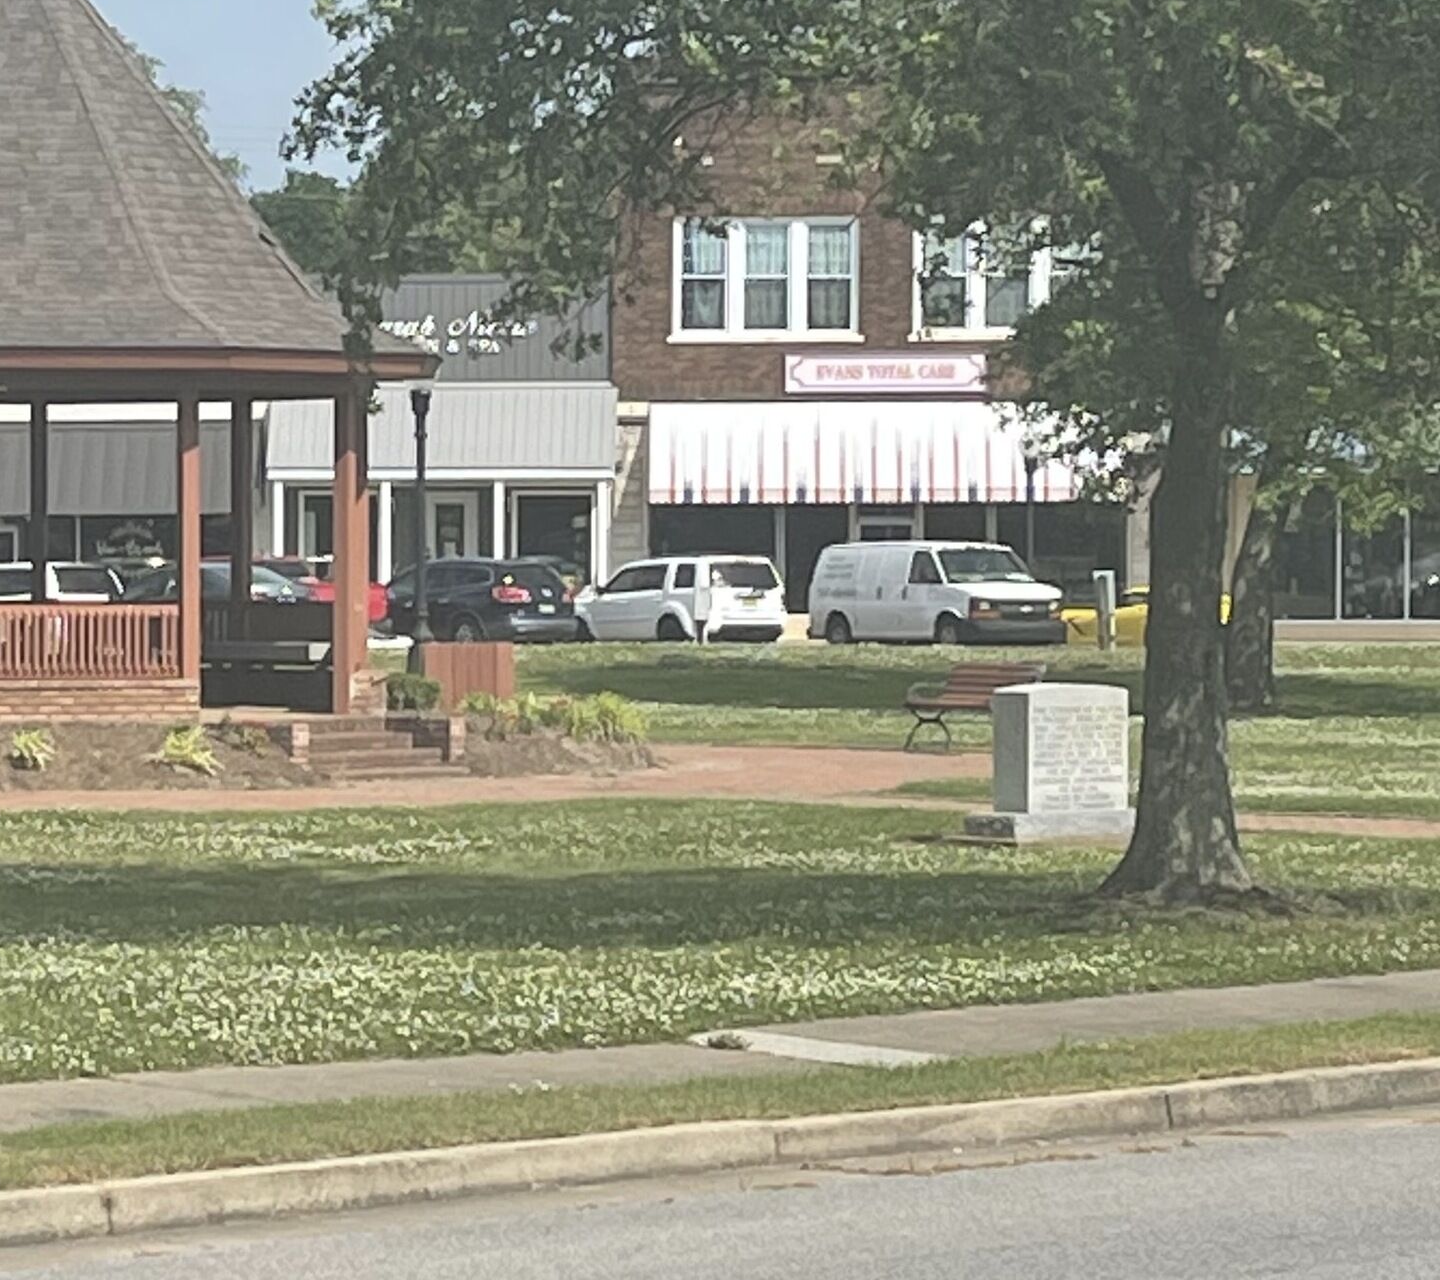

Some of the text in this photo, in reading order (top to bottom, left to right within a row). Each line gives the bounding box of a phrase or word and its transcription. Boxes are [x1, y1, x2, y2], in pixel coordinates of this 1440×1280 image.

[816, 363, 956, 380] EVANS TOTAL CARE
